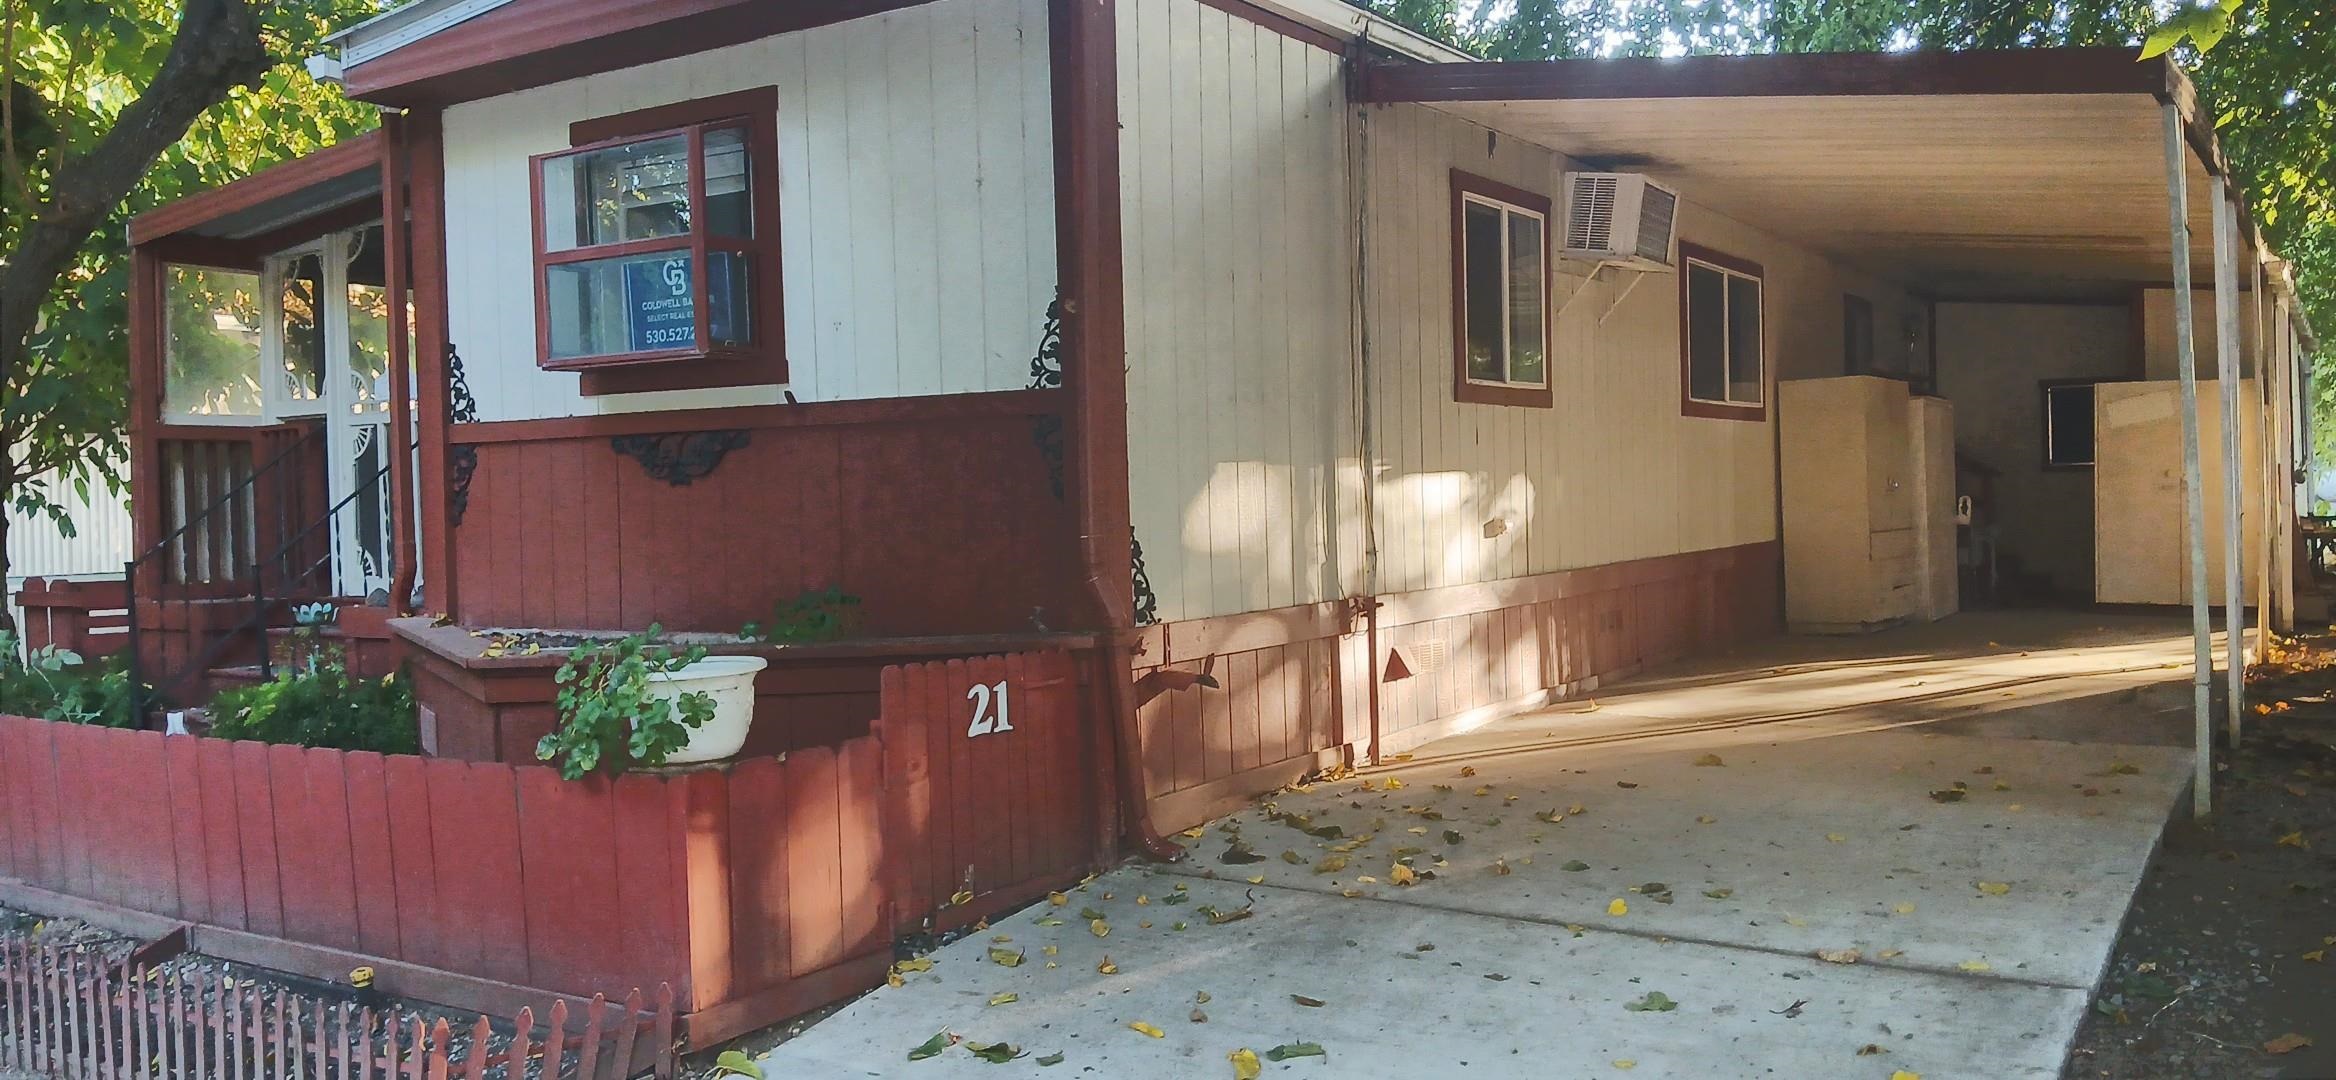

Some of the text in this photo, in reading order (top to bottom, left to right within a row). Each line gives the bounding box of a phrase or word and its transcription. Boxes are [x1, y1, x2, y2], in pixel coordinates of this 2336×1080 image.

[641, 298, 682, 311] COLDWELL
[647, 313, 669, 322] SELECT
[669, 311, 686, 320] REAL
[967, 680, 1014, 738] 21
